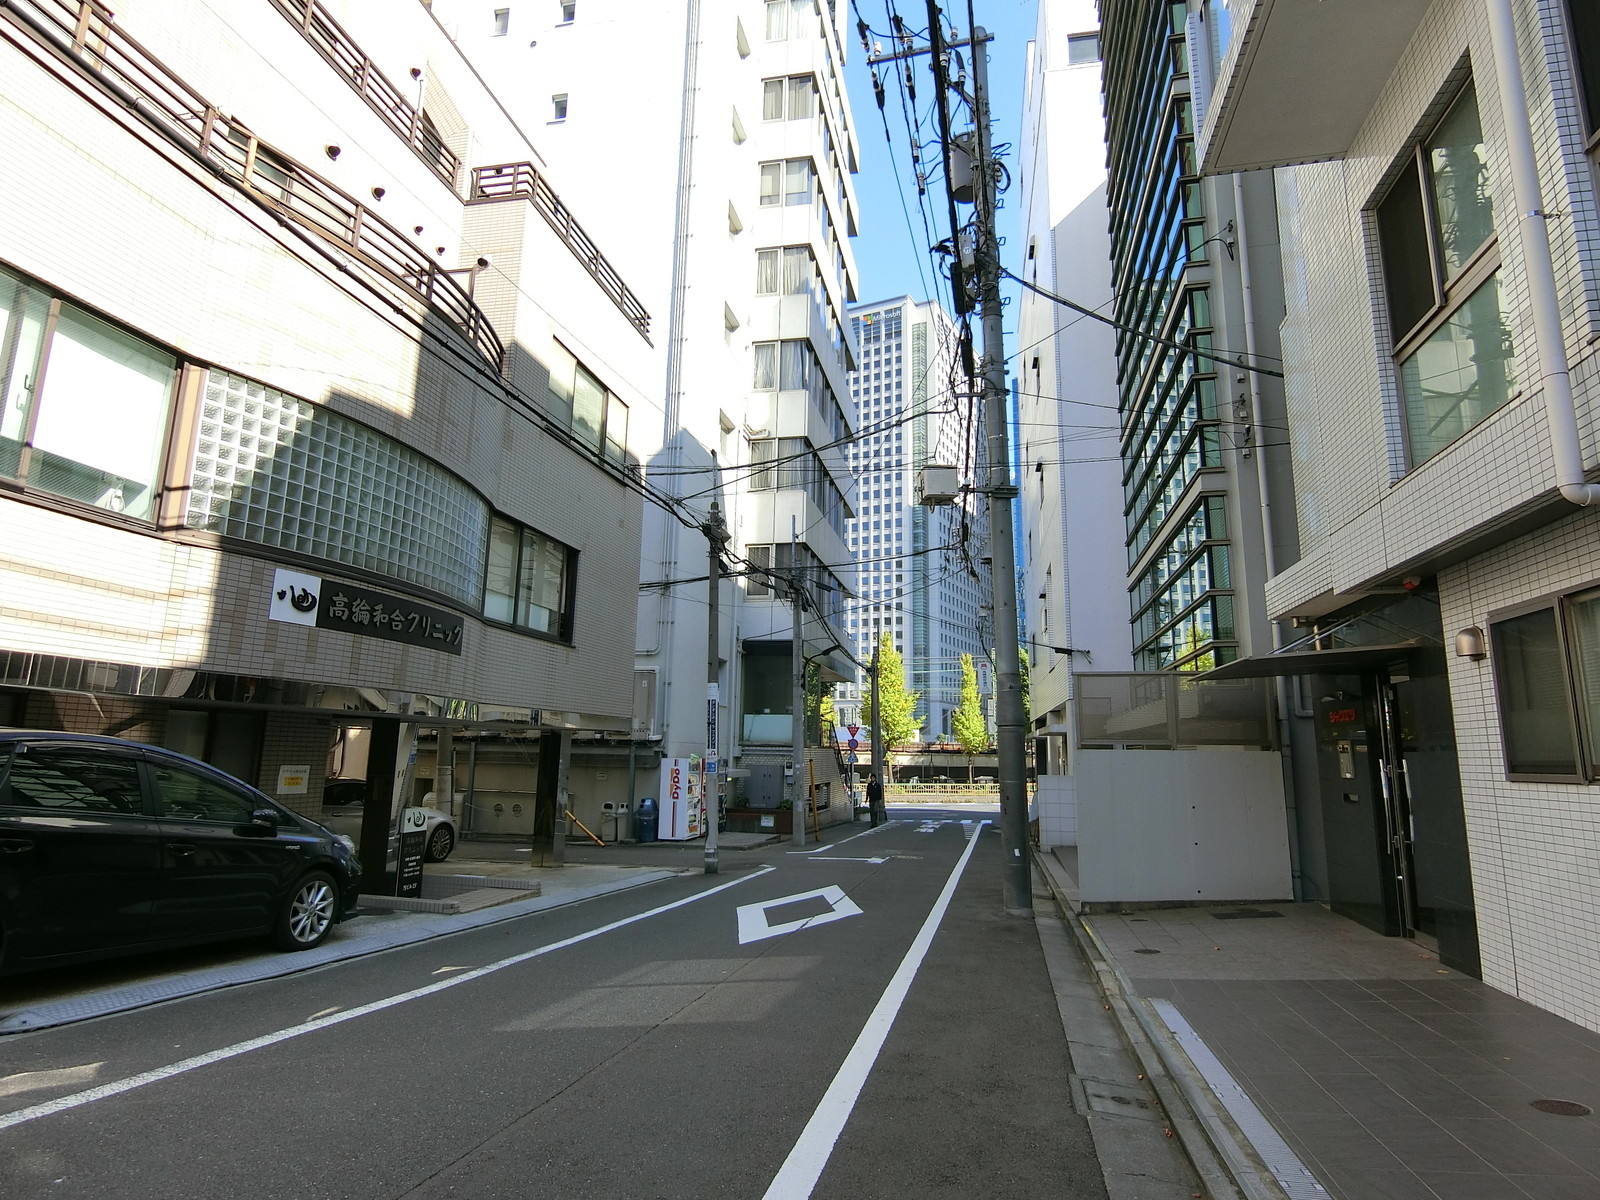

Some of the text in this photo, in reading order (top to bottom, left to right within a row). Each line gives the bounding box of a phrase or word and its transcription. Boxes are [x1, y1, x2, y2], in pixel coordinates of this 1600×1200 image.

[872, 310, 901, 321] Microsoft
[329, 592, 462, 646] 高輪和合クリニック
[672, 768, 682, 800] DyDo
